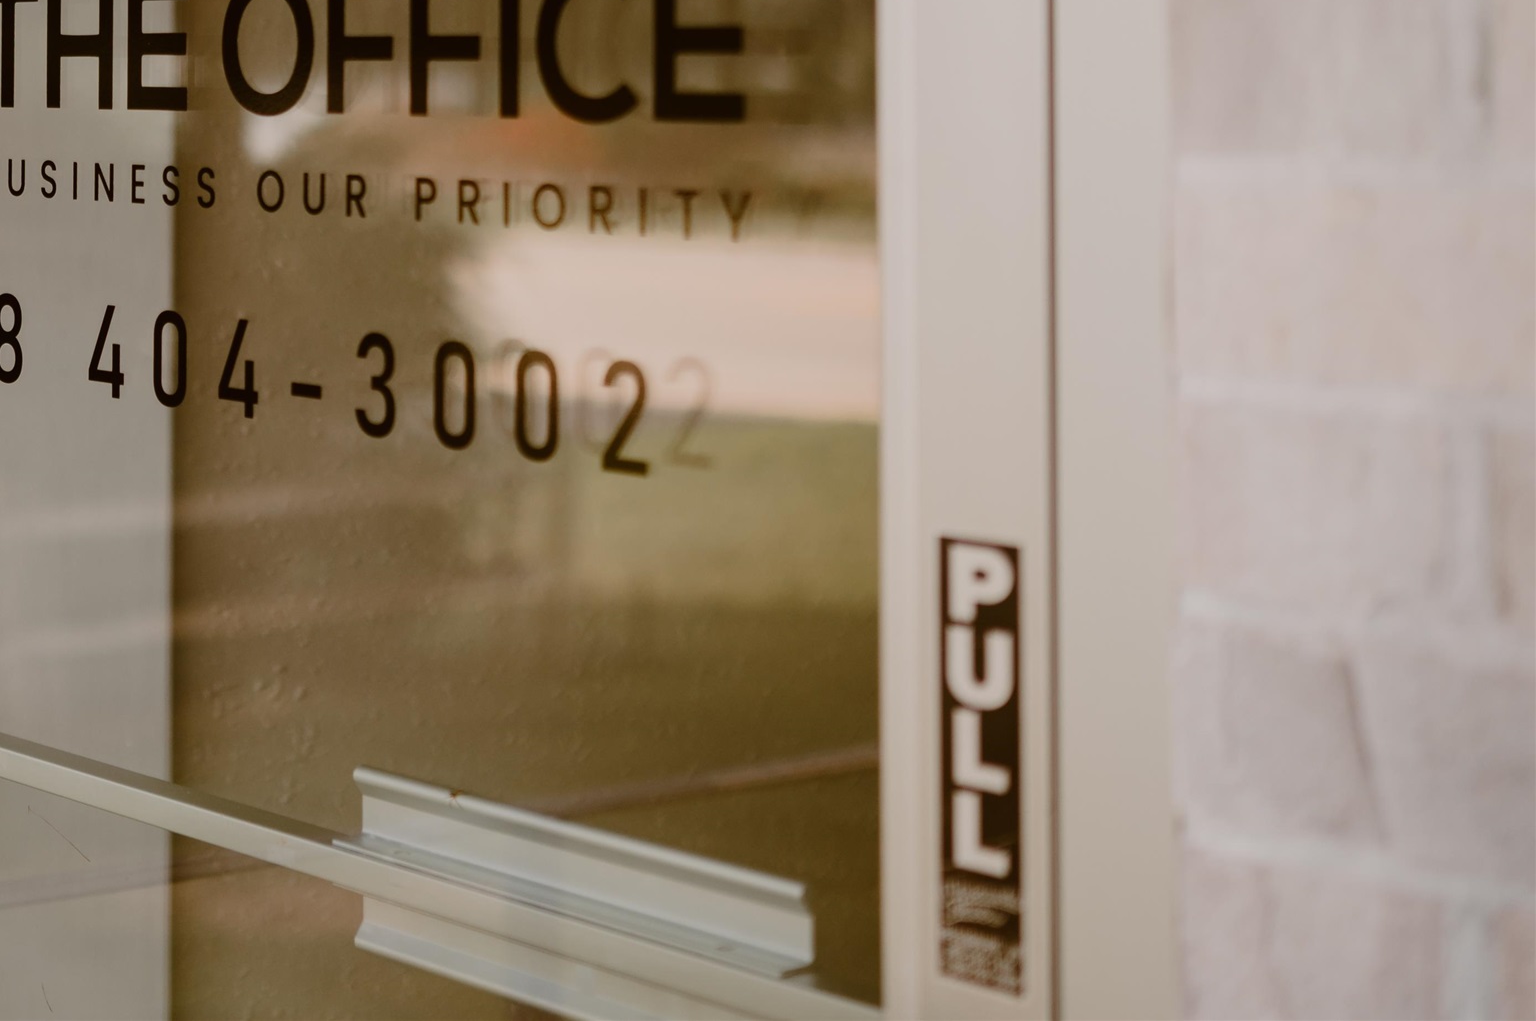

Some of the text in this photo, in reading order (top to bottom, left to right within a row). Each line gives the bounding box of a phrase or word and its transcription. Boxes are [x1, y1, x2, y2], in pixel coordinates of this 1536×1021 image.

[257, 170, 367, 219] OUR
[415, 177, 752, 243] PRIORITY
[946, 543, 1016, 877] PULL
